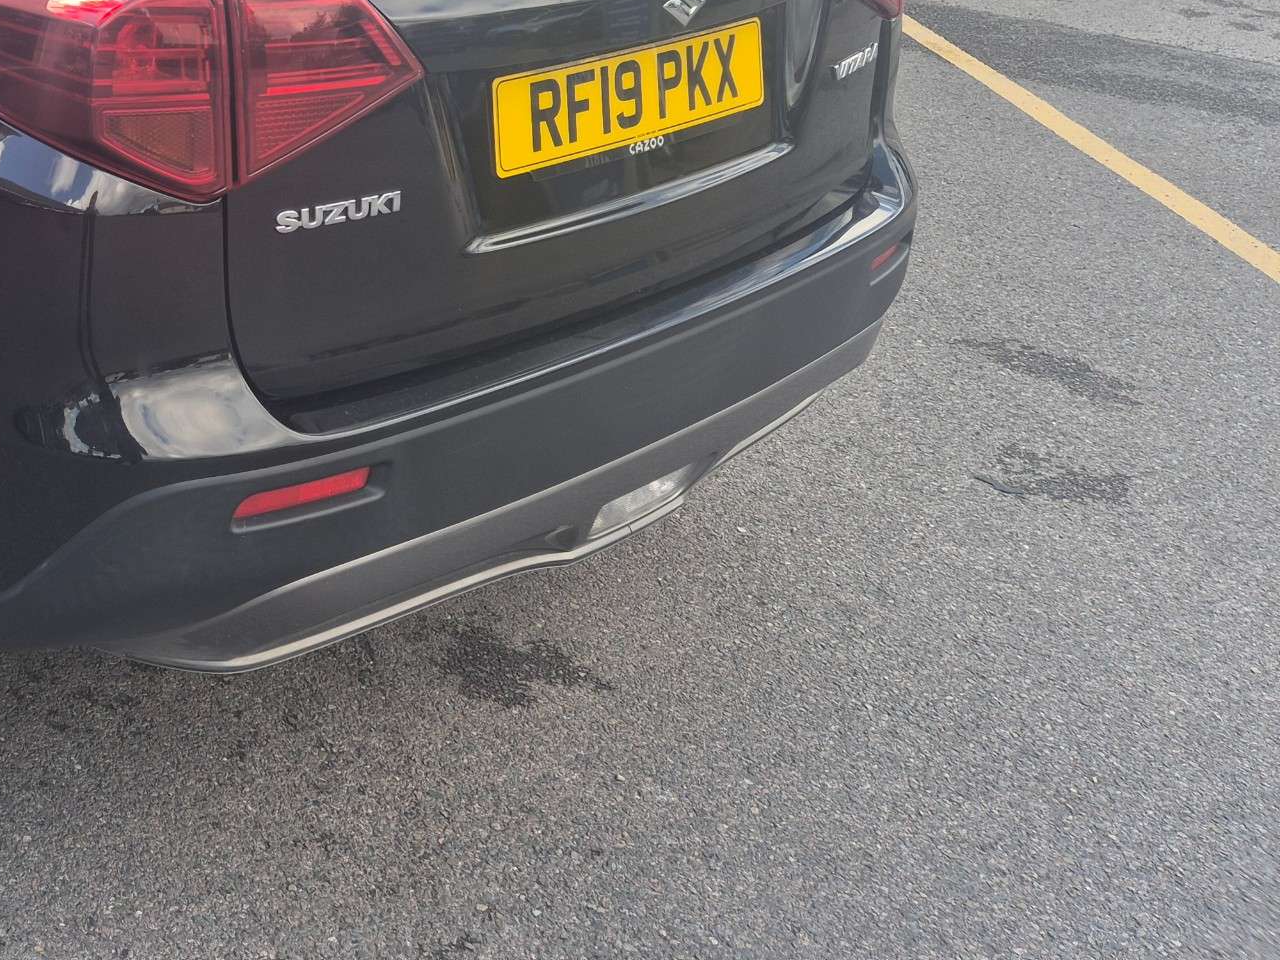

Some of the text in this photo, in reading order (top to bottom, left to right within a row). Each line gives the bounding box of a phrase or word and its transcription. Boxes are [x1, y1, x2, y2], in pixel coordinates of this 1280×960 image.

[529, 34, 739, 153] RF19 PKX
[629, 136, 664, 155] CAZOO
[275, 191, 401, 234] SUZUKI
